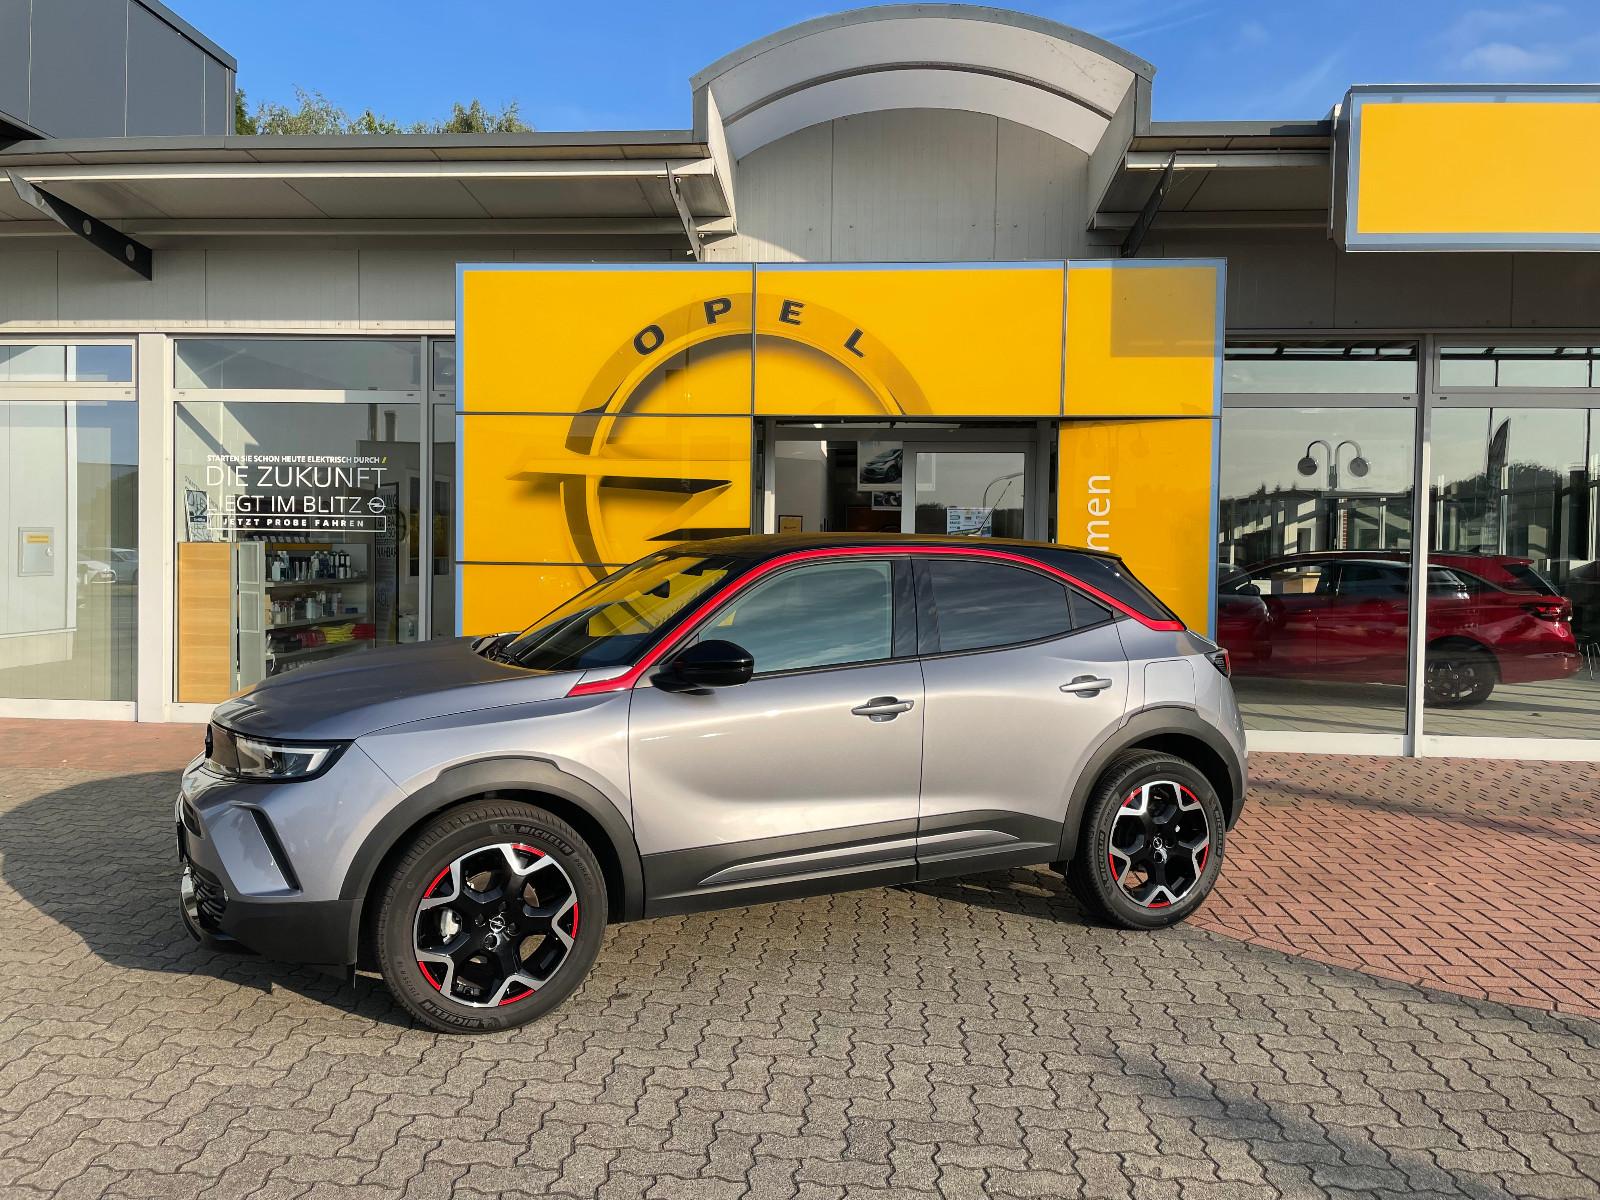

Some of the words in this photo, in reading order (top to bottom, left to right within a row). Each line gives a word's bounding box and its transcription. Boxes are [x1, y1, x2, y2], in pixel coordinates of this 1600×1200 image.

[633, 297, 865, 359] OPEL
[253, 455, 280, 463] SCHON
[281, 455, 306, 463] HEUTE
[353, 456, 380, 464] DURCH
[206, 465, 249, 487] DIE
[256, 465, 388, 489] ZUKUNFT
[206, 494, 265, 512] LIEGT
[271, 495, 295, 513] IM
[303, 495, 362, 513] BLITZ
[223, 518, 260, 526] JETZT
[266, 518, 307, 527] PROBE
[314, 519, 364, 528] FAHREN
[518, 824, 574, 855] MICHELIN
[421, 1001, 480, 1028] MICHELIN
